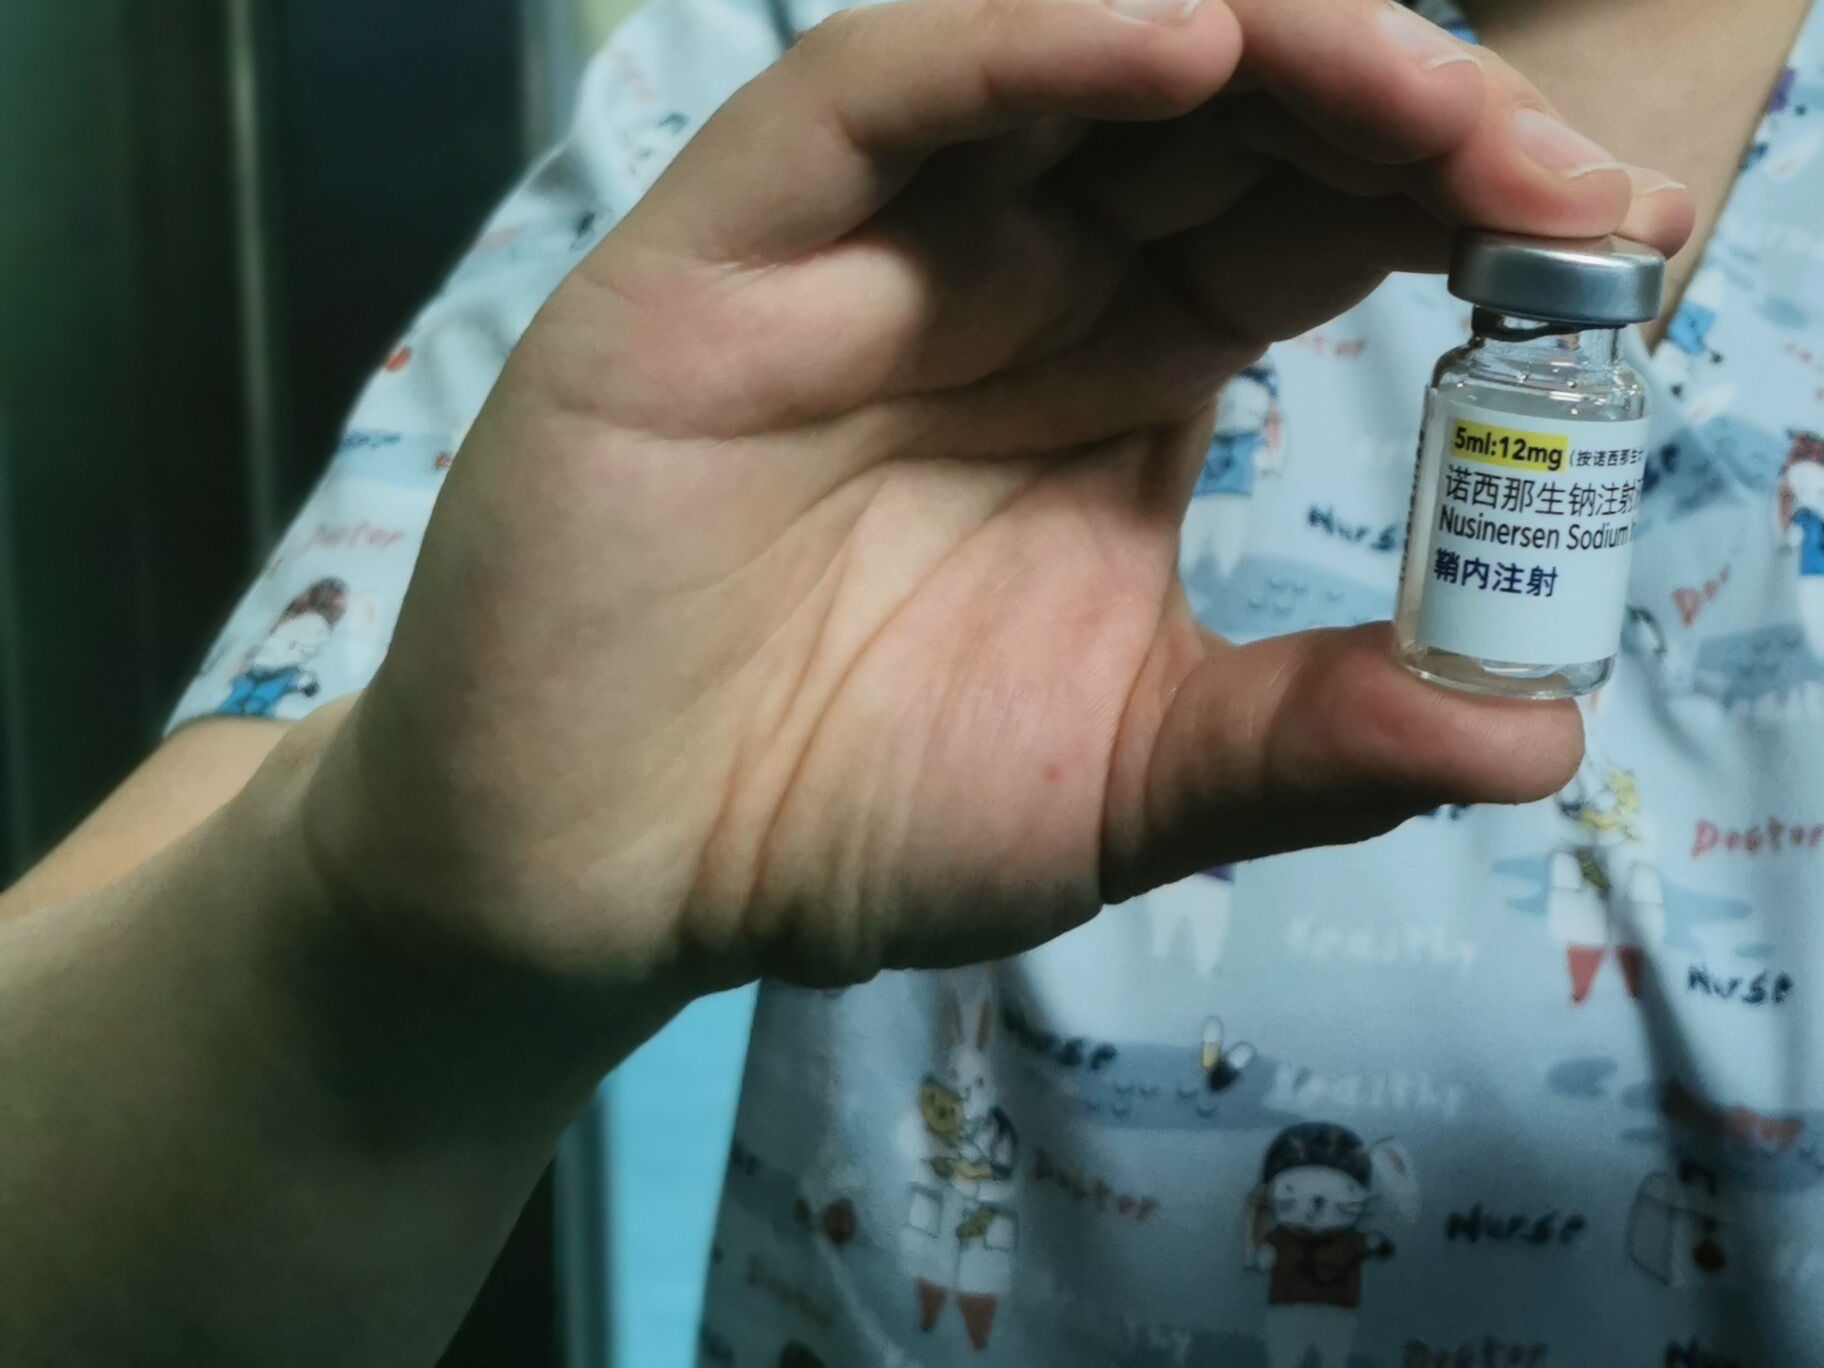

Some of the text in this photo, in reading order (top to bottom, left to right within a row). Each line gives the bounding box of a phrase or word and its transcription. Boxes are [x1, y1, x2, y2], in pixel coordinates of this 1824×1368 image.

[1454, 426, 1563, 472] 5ml:12mg
[1439, 504, 1630, 550] Nusinersen Sodium
[1433, 547, 1558, 597] 鞘内注射
